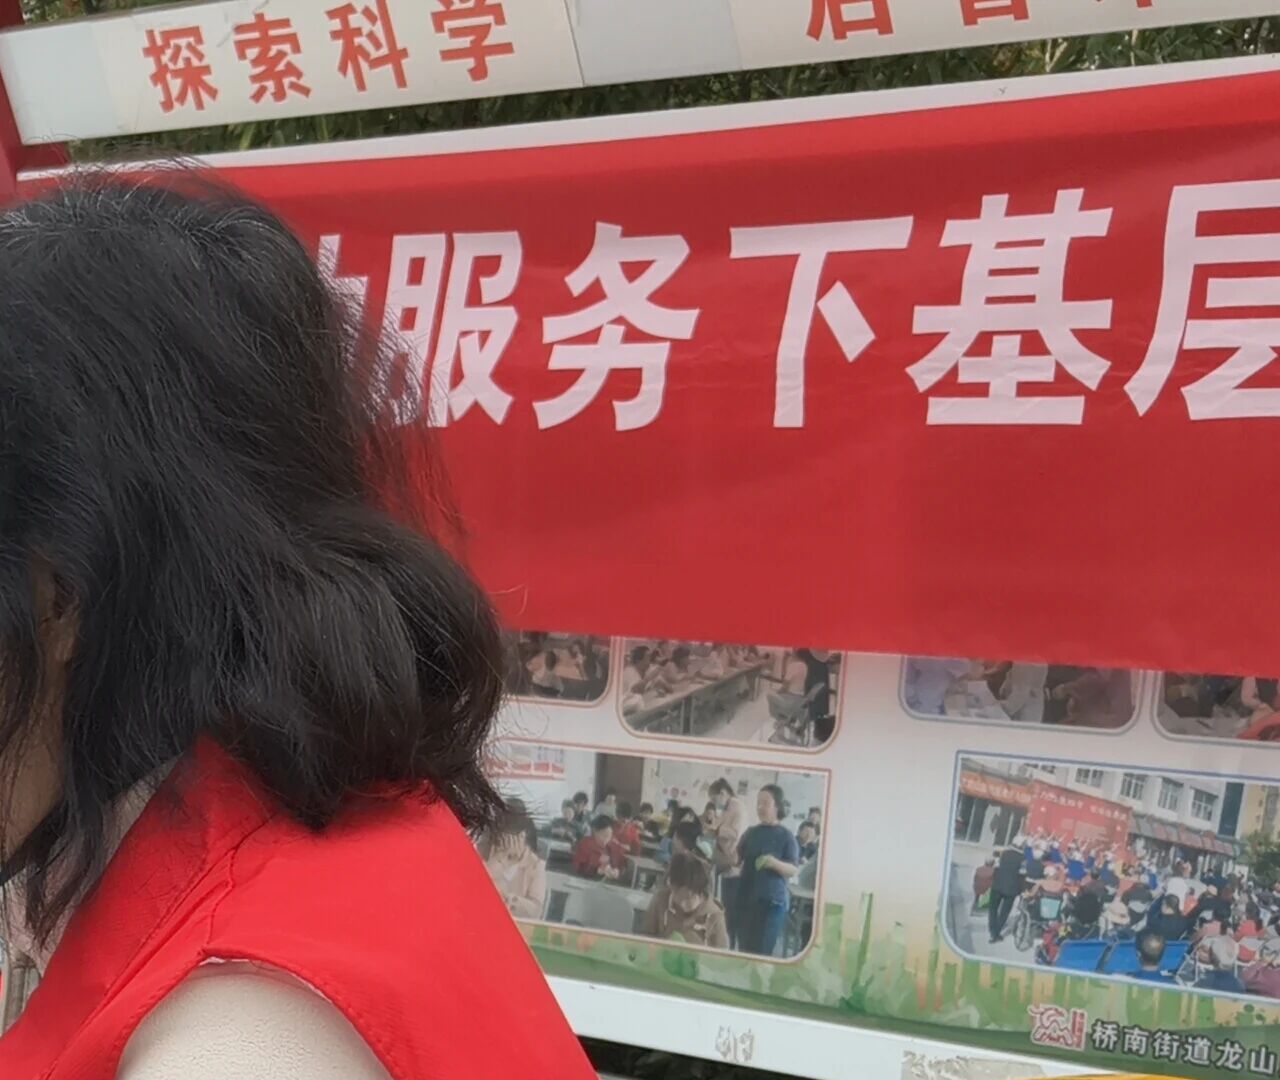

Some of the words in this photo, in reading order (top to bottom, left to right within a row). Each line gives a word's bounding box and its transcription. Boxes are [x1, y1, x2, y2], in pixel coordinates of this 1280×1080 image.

[142, 0, 515, 113] 探索科学
[1092, 1019, 1276, 1076] 桥南街道龙山
